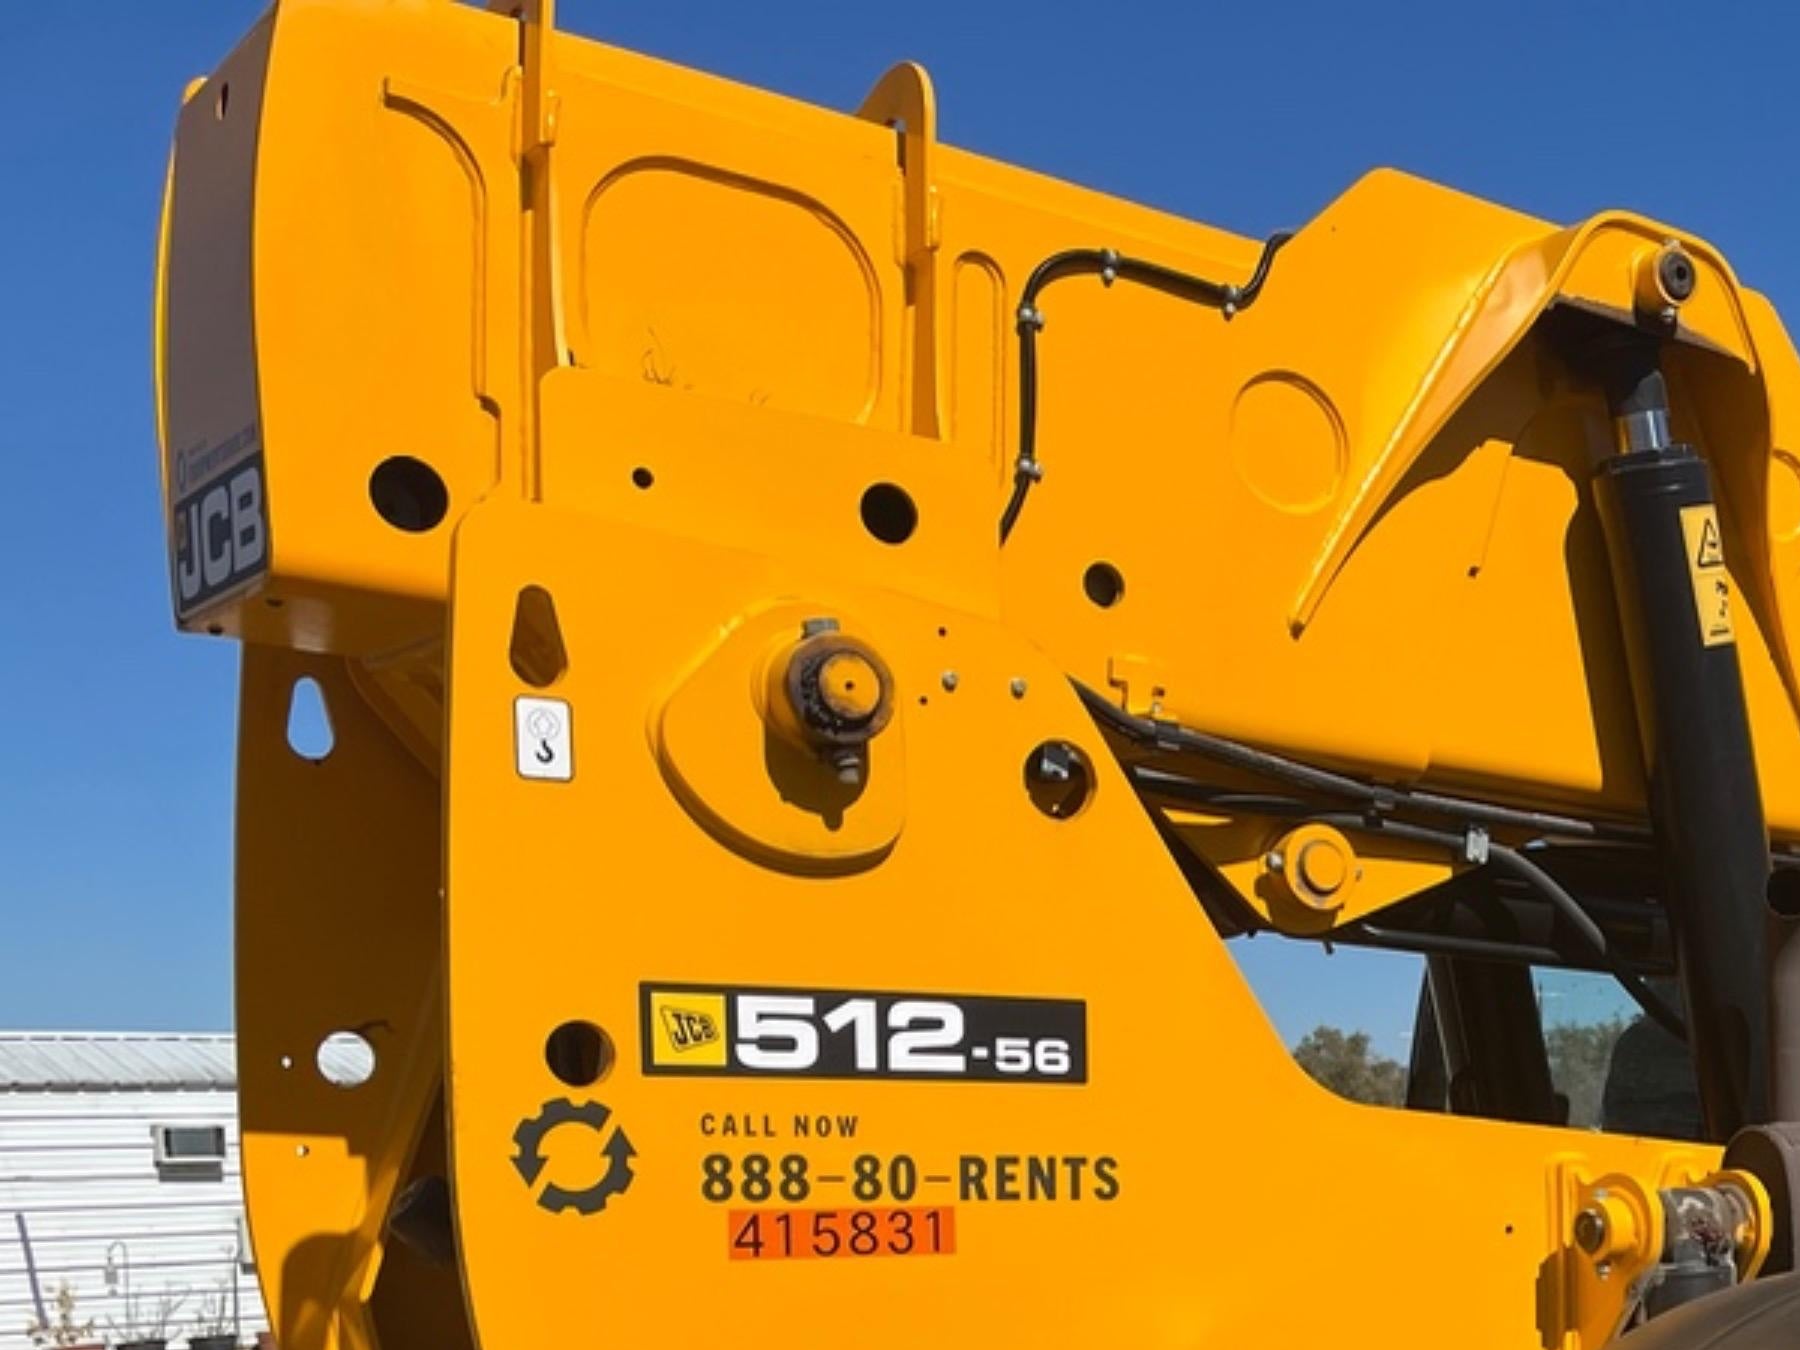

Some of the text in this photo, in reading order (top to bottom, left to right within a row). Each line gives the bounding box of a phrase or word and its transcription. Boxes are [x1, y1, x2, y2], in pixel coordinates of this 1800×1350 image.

[179, 466, 264, 599] JCB
[735, 994, 1071, 1075] 512-56
[700, 1113, 859, 1138] CALL NOW
[701, 1153, 1121, 1203] 888-80-RENTS
[733, 1211, 943, 1258] 415831
